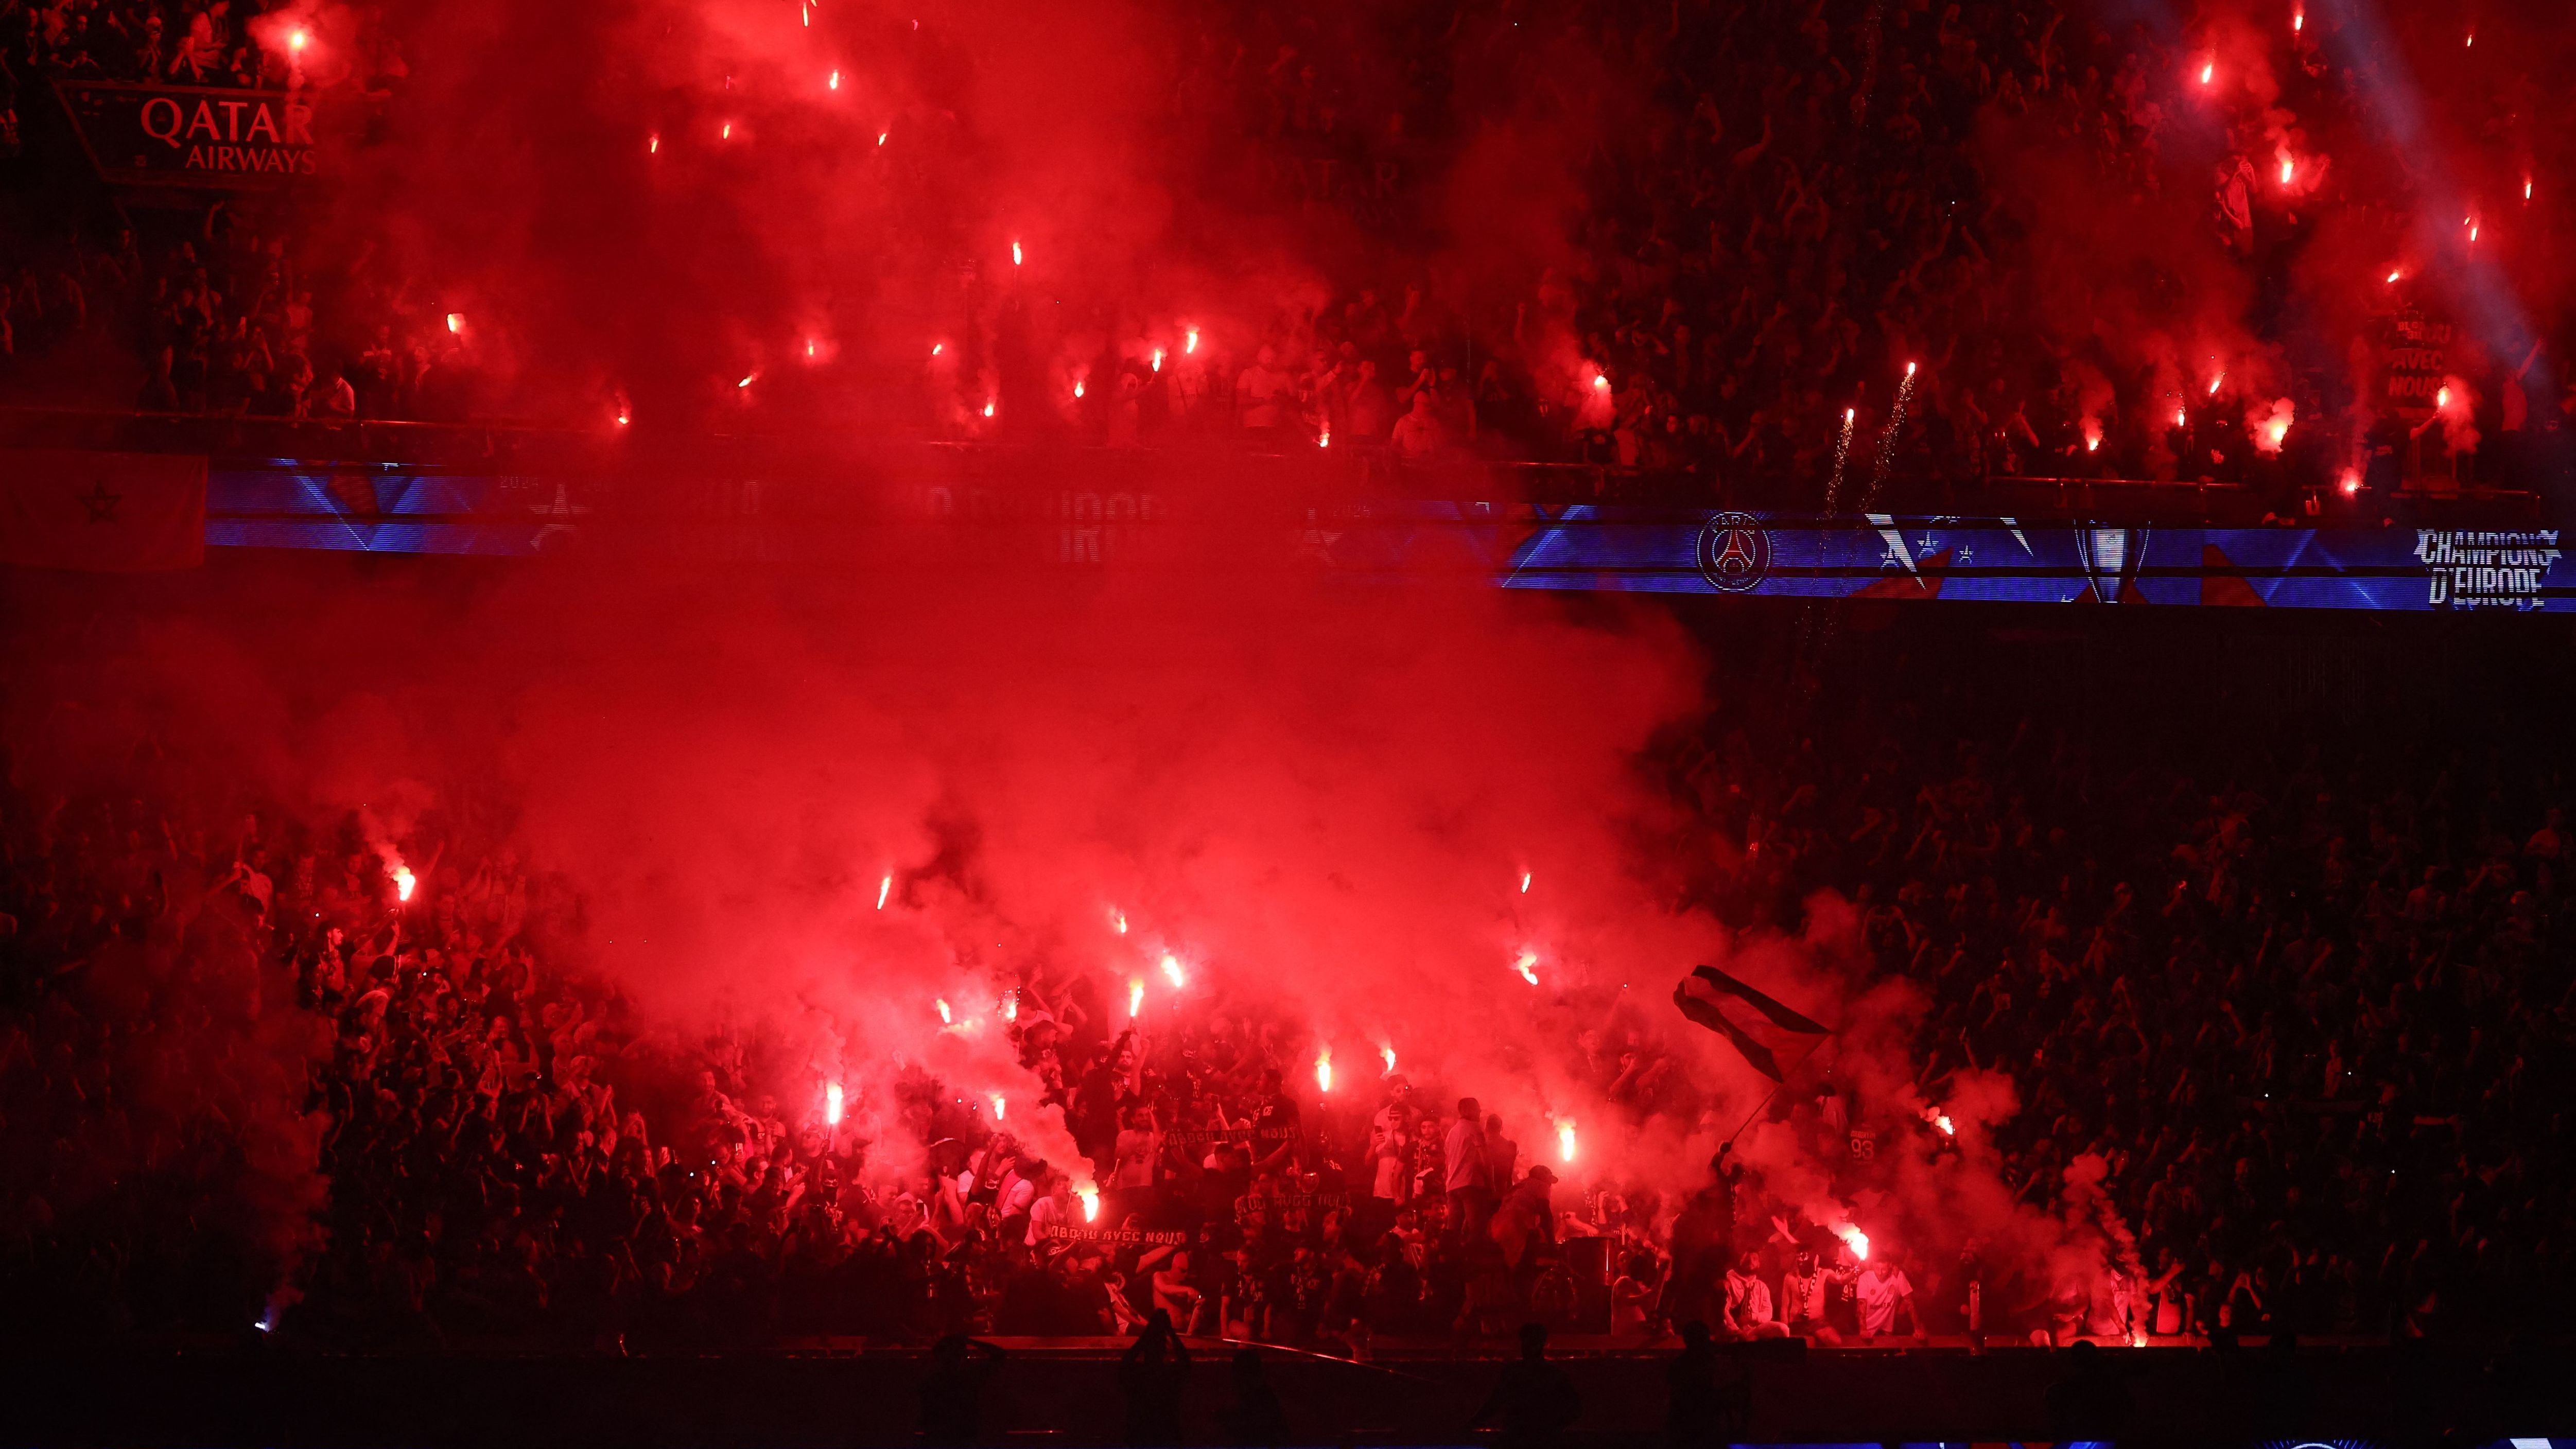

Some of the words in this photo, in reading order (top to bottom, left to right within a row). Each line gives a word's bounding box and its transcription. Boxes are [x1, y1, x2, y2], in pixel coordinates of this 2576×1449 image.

[141, 97, 314, 148] QATAR
[186, 146, 317, 174] AIRWAYS
[2393, 350, 2444, 371] AVEC
[2420, 529, 2554, 566] CHAMPIONS
[2429, 567, 2545, 606] D'EUROPE
[1851, 1139, 1874, 1160] 93
